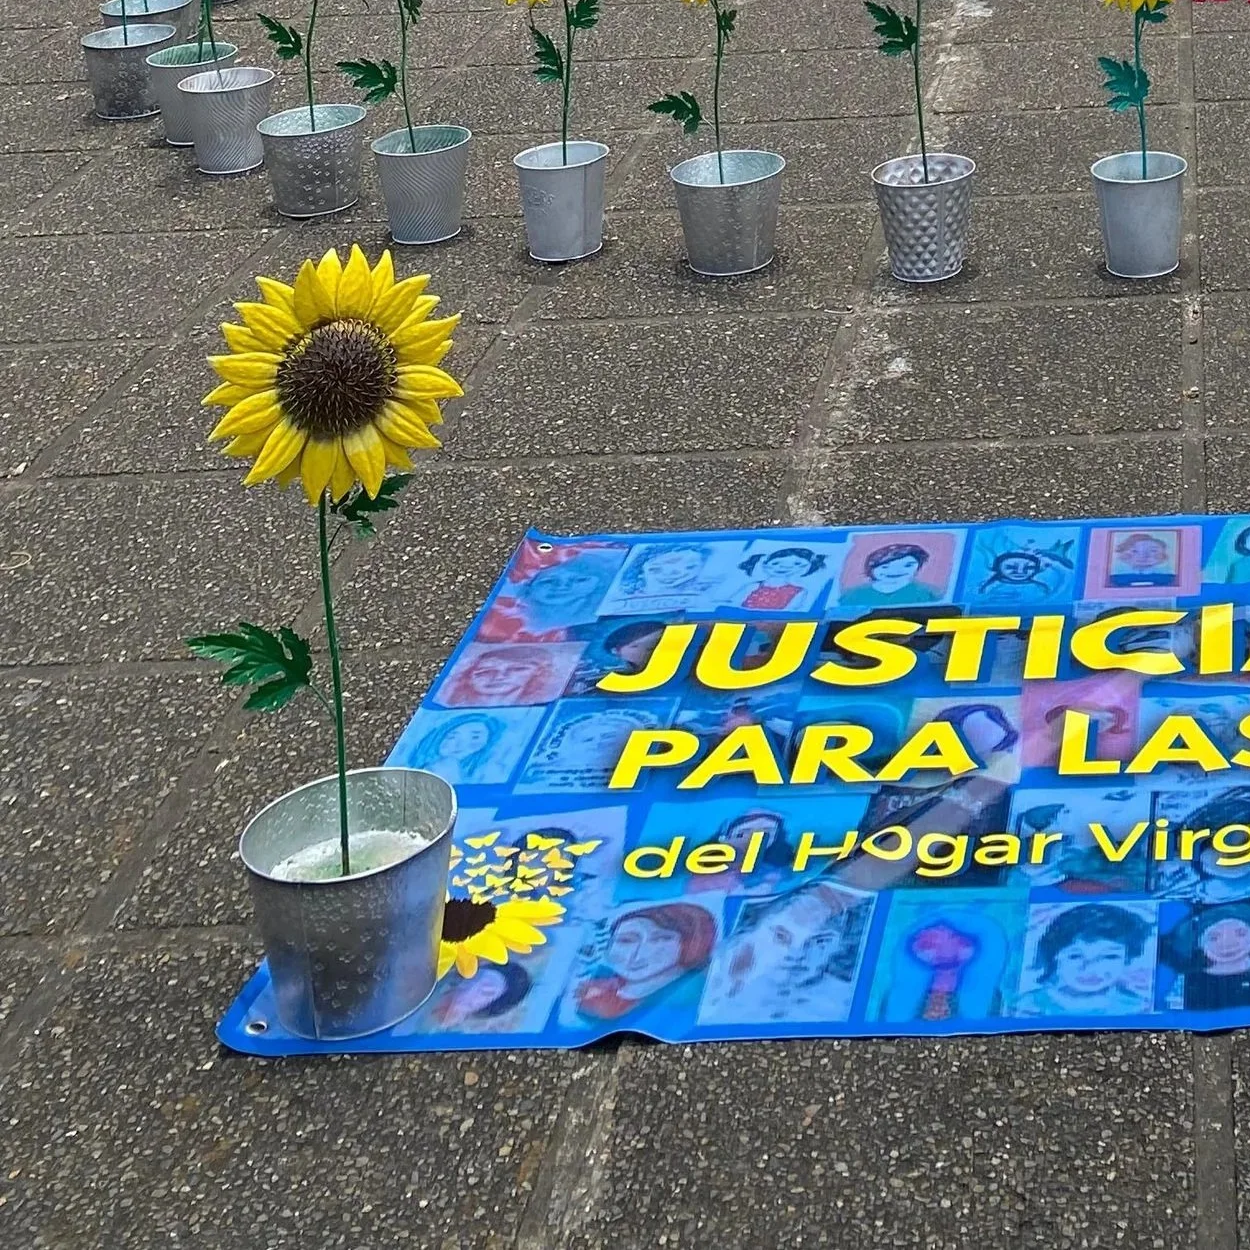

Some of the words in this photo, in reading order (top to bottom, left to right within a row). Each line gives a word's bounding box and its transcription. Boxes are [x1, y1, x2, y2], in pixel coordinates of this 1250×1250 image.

[608, 721, 978, 789] PARA
[623, 831, 763, 878] del
[794, 826, 1053, 877] Hogar
